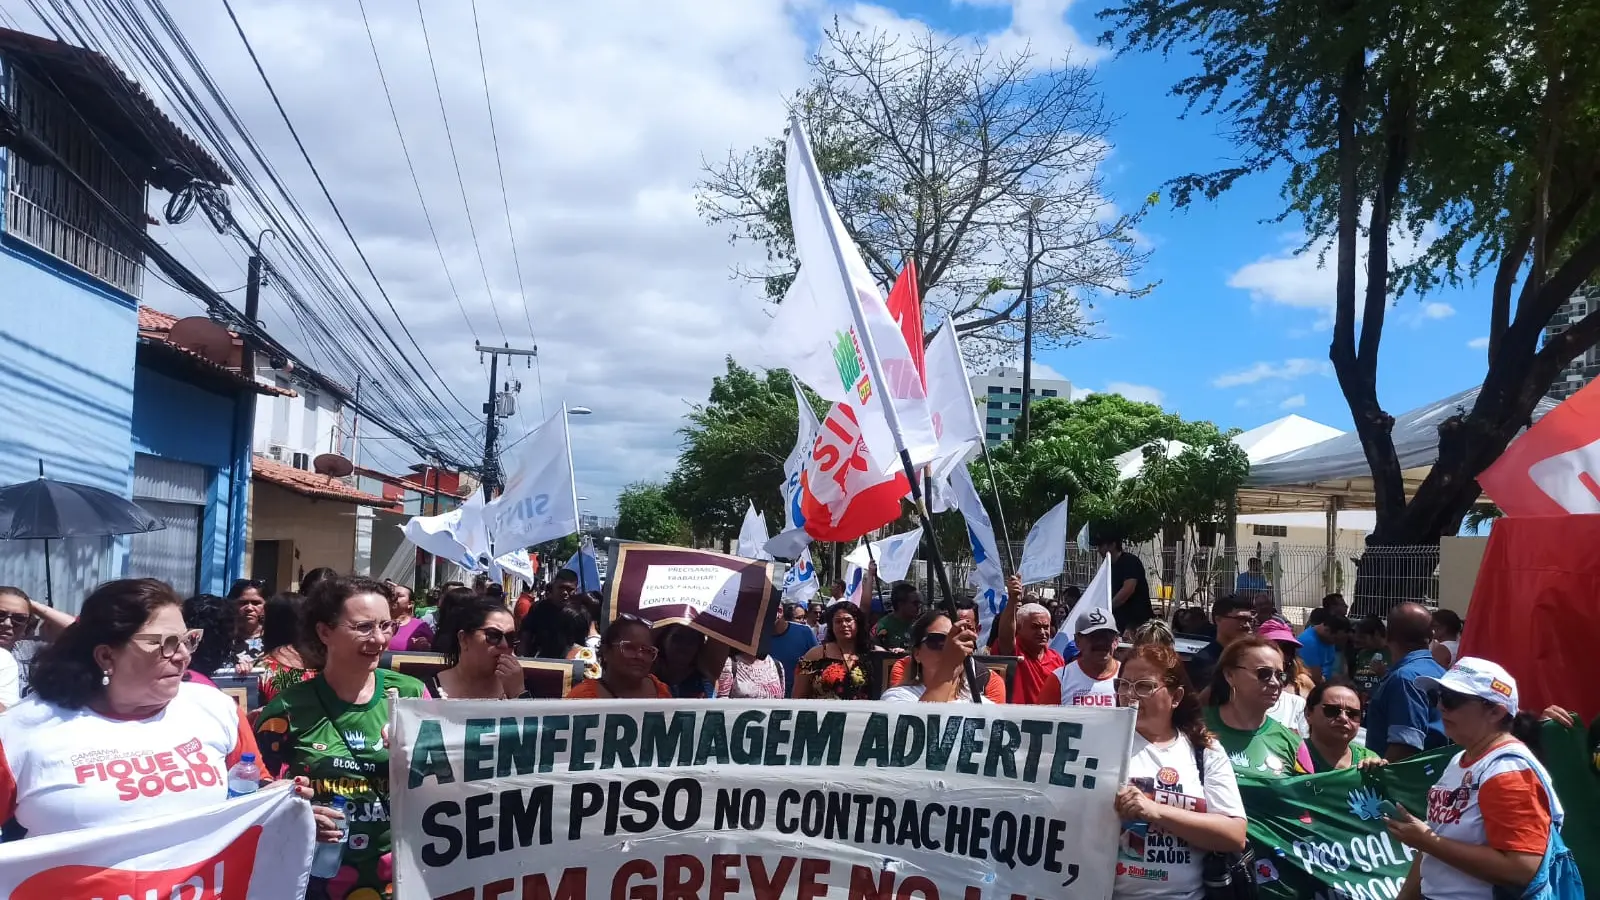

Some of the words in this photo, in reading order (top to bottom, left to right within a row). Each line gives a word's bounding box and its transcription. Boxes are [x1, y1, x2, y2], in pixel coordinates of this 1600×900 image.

[643, 597, 676, 605] CONTAS
[407, 719, 453, 788] A
[464, 711, 846, 781] ENFERMAGEM
[854, 713, 1099, 790] ADVERTE:
[74, 752, 178, 784] FIQUE
[421, 785, 553, 868] SEM
[569, 778, 702, 841] PISO
[714, 787, 765, 830] NO
[776, 791, 1081, 886] CONTRACHEQUE,
[1146, 847, 1191, 864] SAÚDE
